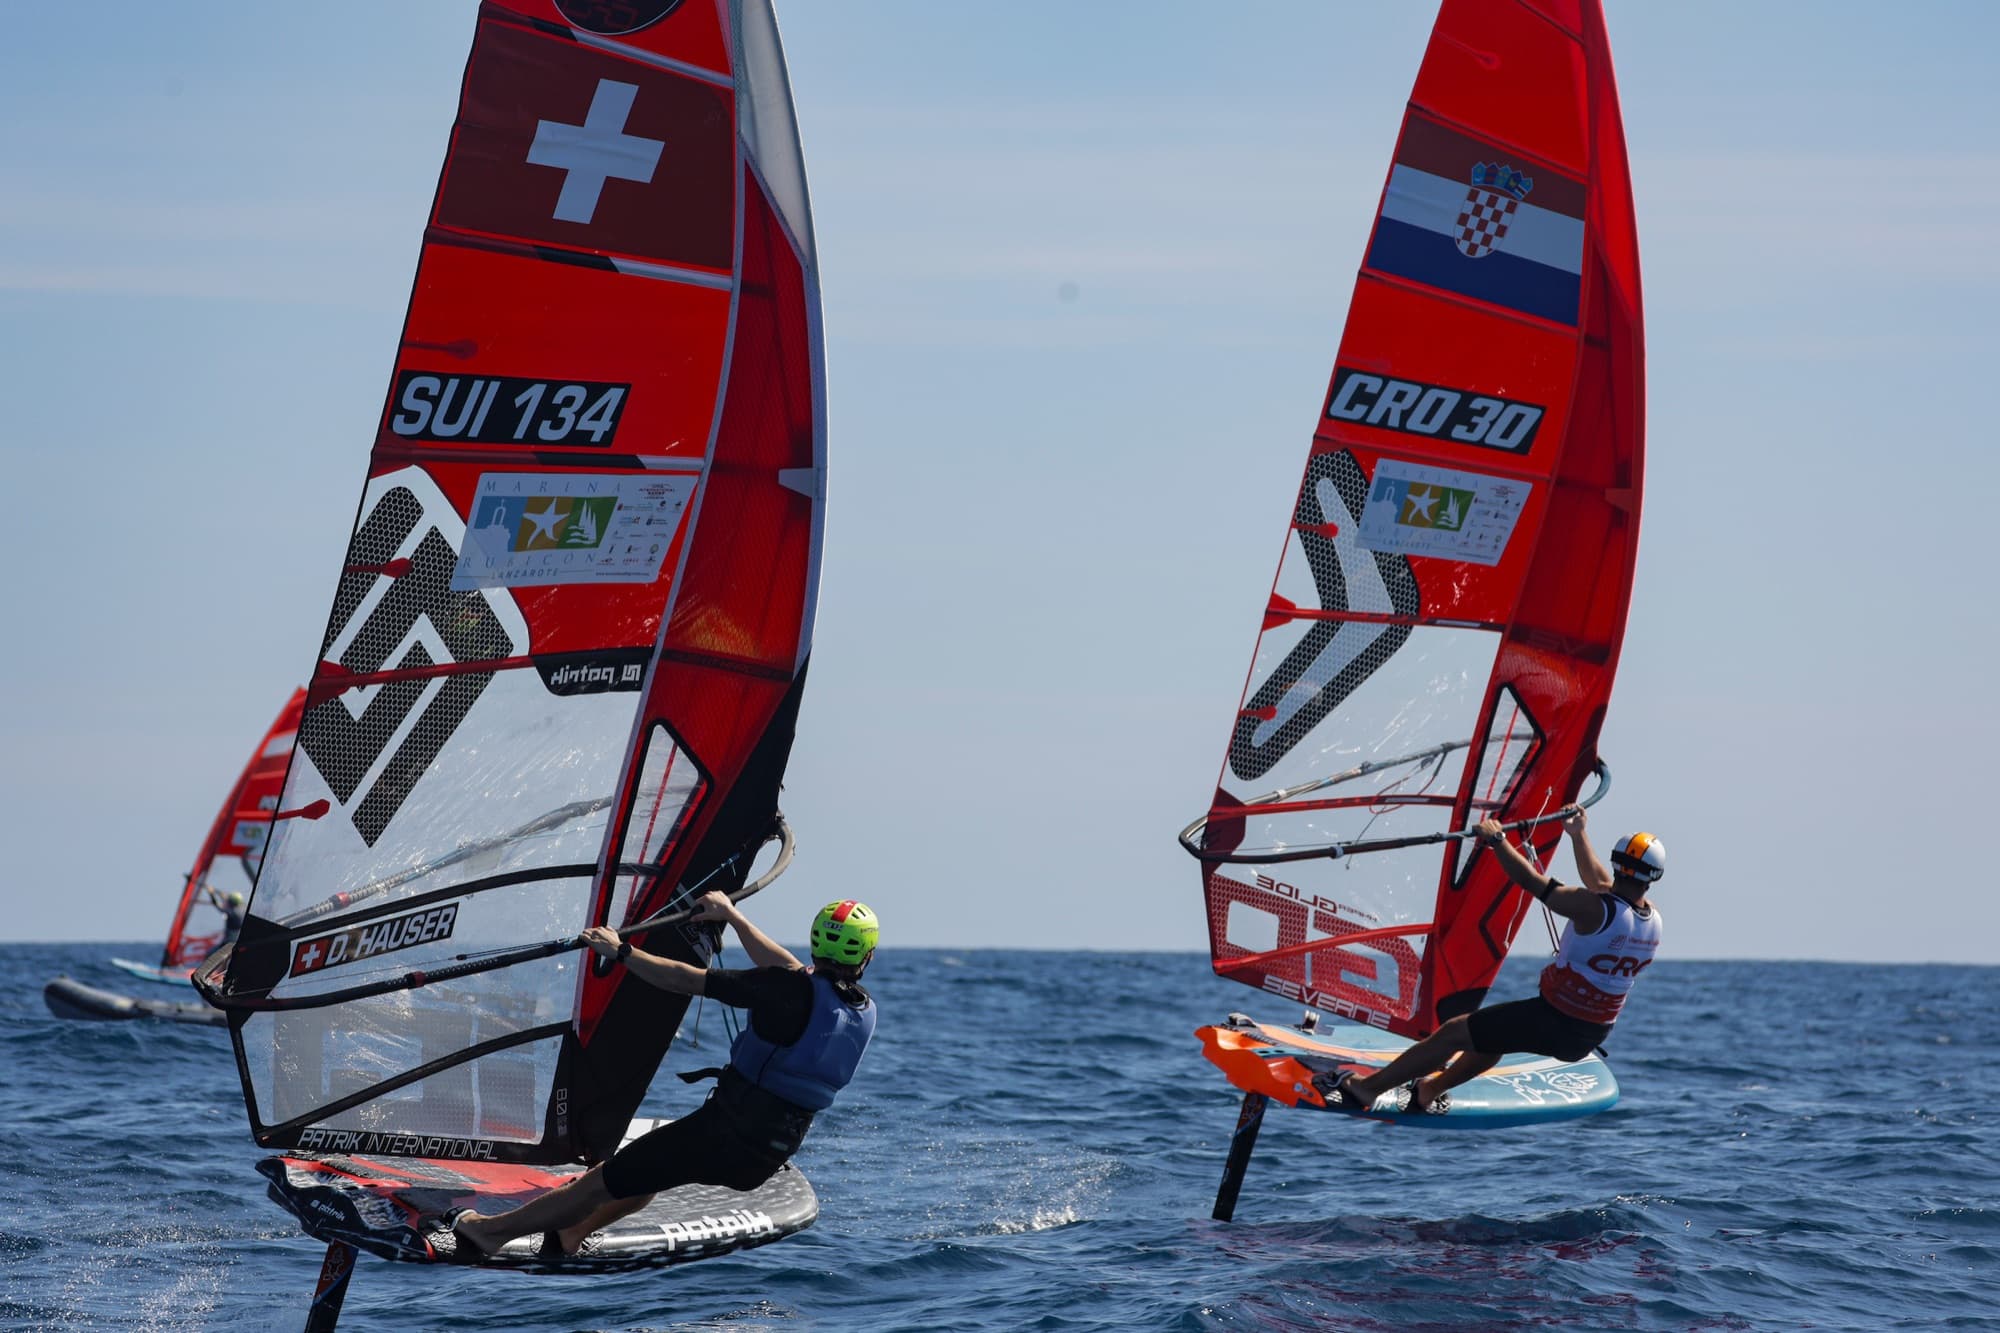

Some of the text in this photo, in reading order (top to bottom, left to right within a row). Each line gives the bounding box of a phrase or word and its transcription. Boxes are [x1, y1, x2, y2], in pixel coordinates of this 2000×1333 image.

[392, 376, 625, 442] SUI 134
[1329, 374, 1543, 449] CRO 30
[484, 481, 621, 493] MARINA
[491, 568, 559, 579] LANZAROTE
[324, 906, 457, 966] D. HAUSER
[1263, 975, 1391, 1029] SEVERNE
[297, 1129, 498, 1160] PATRIK INTERNATIONAL
[659, 1209, 774, 1251] patrik
